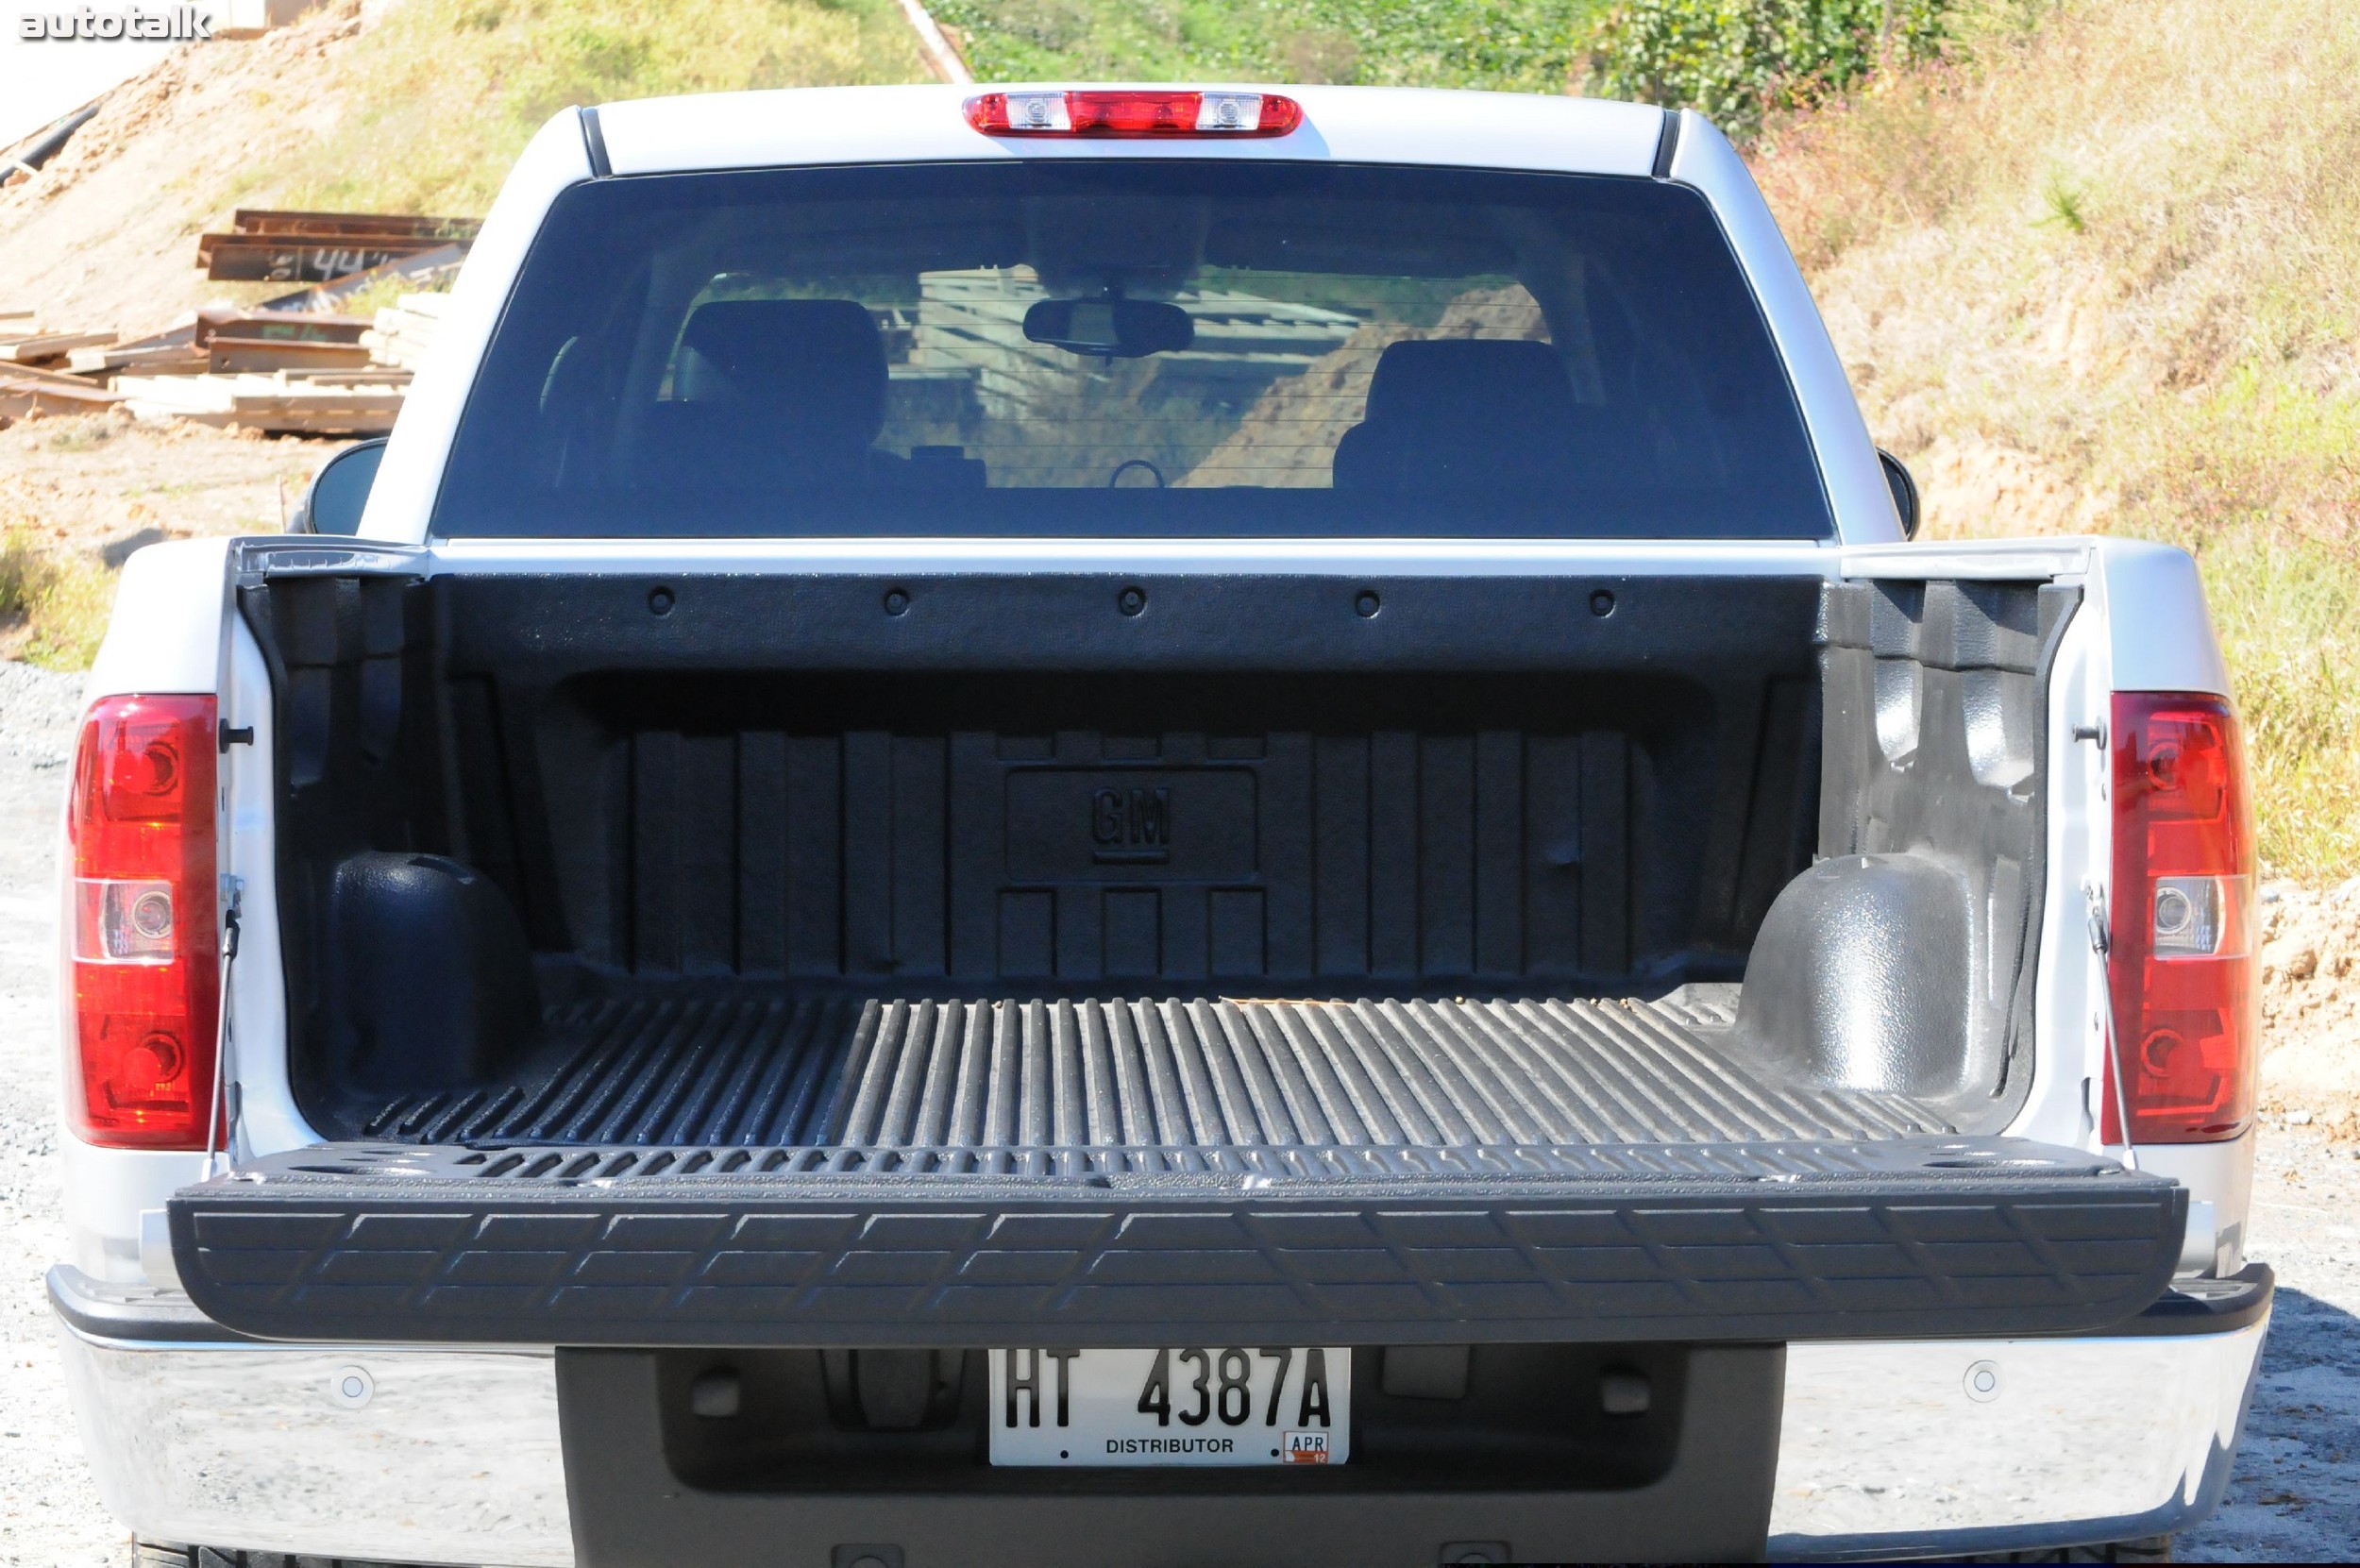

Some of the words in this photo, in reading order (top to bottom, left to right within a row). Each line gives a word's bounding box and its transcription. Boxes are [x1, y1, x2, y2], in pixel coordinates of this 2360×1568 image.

[1092, 786, 1170, 844] GM
[1005, 1348, 1081, 1427] HT
[1138, 1348, 1331, 1427] 4387A
[1106, 1438, 1234, 1454] DISTRIBUTOR
[1292, 1436, 1323, 1452] APR
